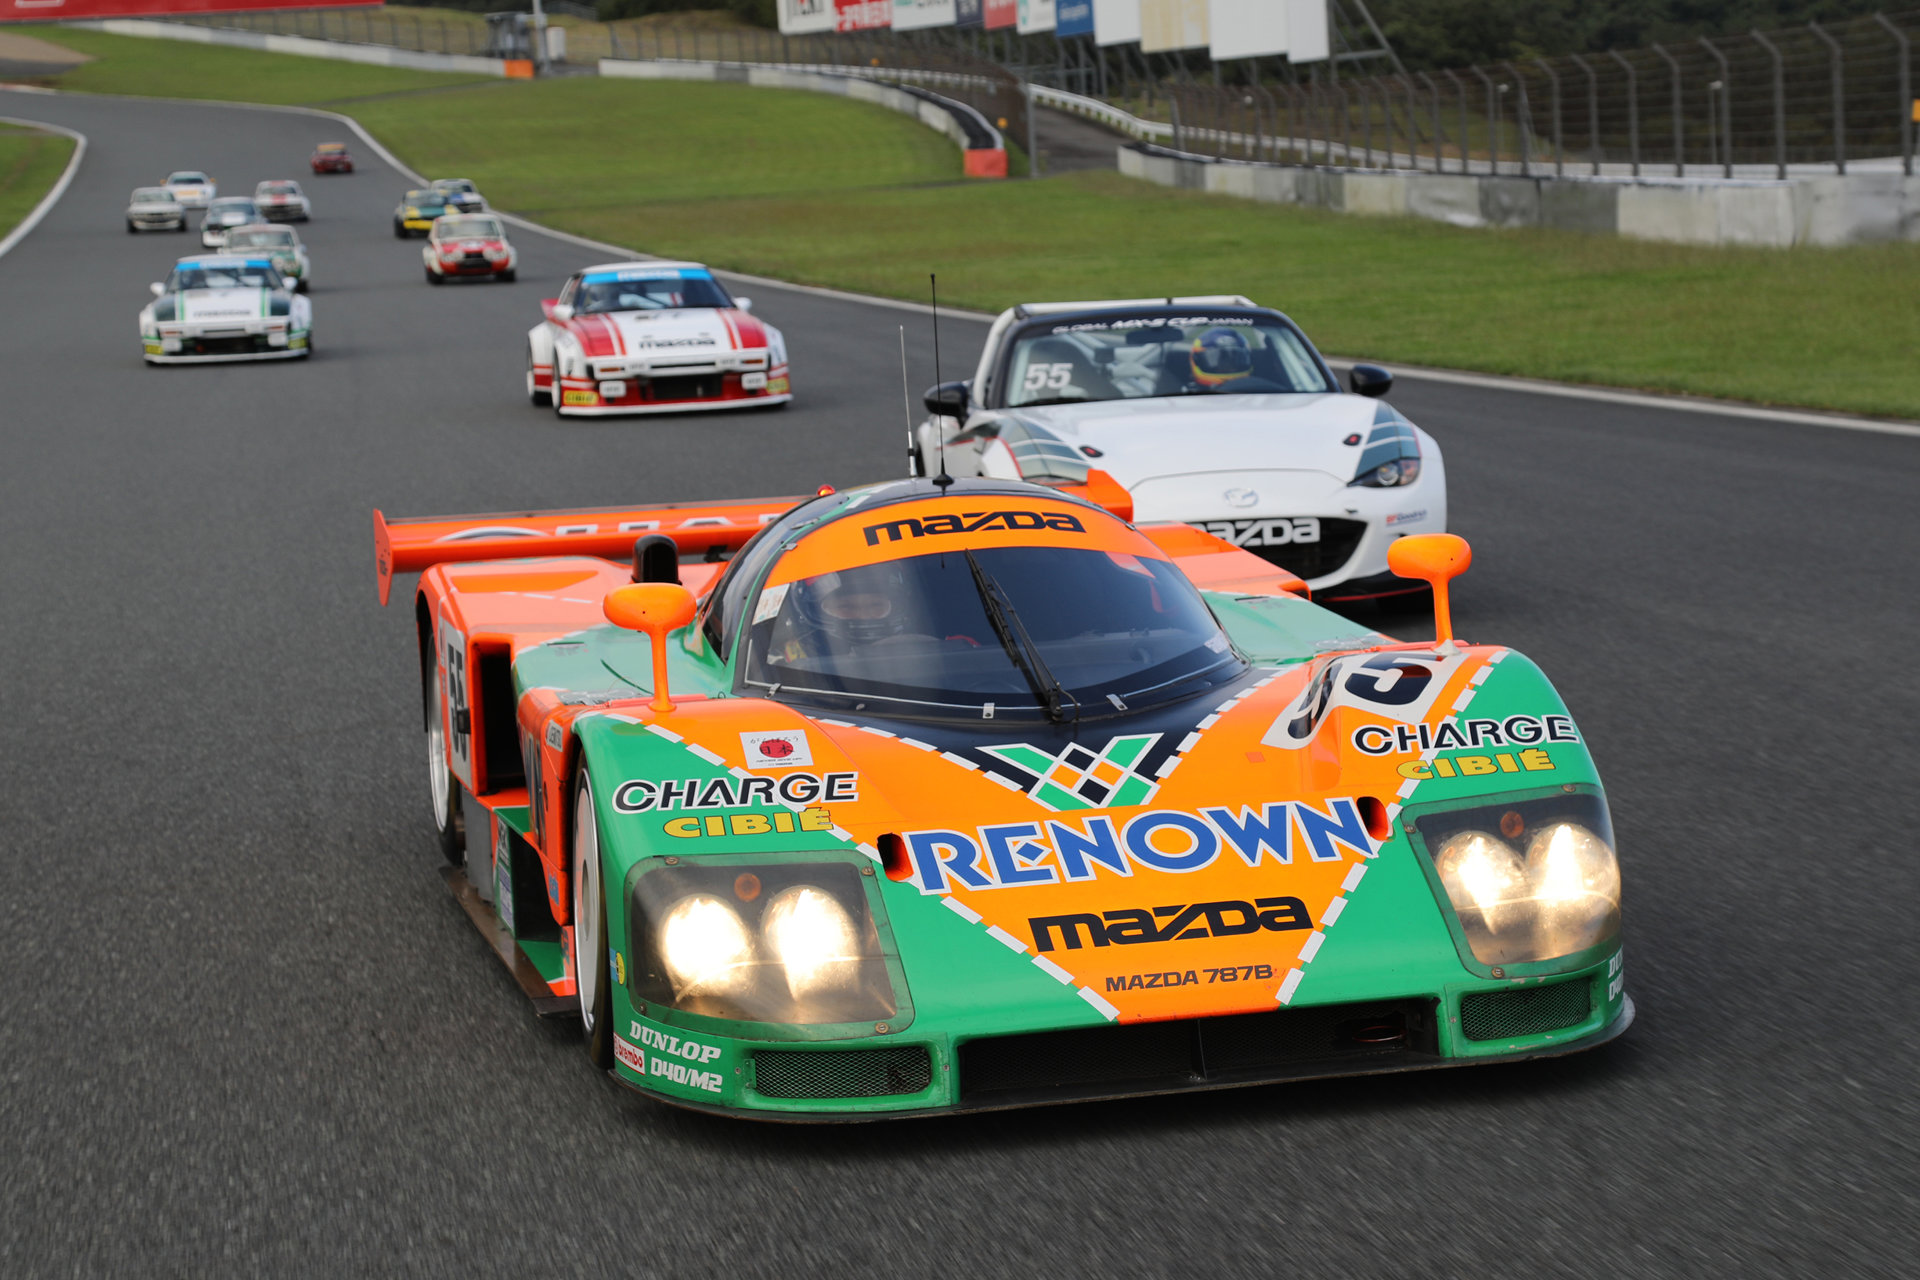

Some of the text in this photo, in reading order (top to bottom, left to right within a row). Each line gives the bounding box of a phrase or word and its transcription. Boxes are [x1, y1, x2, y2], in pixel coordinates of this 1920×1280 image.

[1024, 362, 1073, 390] 55
[862, 511, 1087, 547] mazda
[1351, 714, 1580, 756] CHARGE
[612, 772, 859, 814] CHARGE
[902, 796, 1379, 896] RENOWN
[1028, 896, 1314, 952] mazda
[1105, 964, 1273, 992] MAZDA 787B
[617, 1042, 643, 1068] brembo
[629, 1020, 722, 1064] DUNLOP
[650, 1056, 723, 1093] D40/M2
